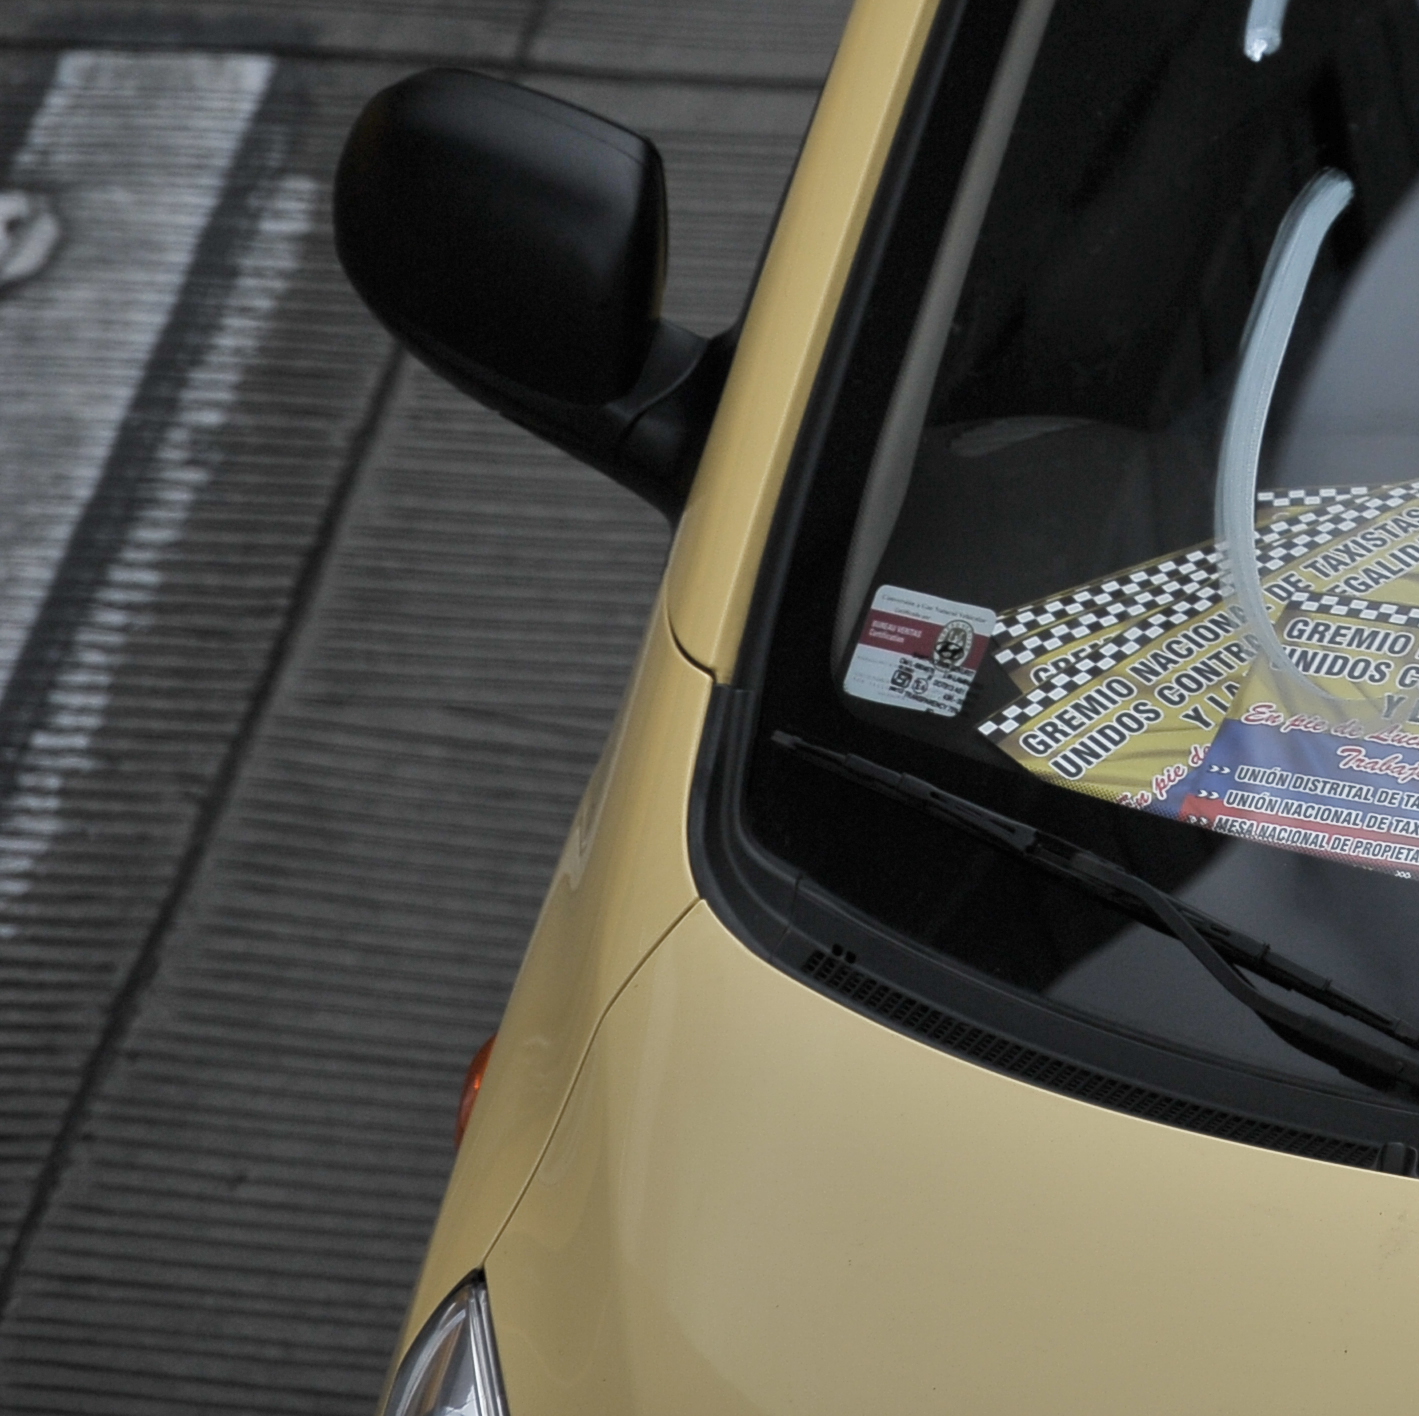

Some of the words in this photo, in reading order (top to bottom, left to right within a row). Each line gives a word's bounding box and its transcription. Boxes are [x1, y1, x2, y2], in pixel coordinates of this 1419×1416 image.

[1285, 617, 1414, 656] GREMIO
[1019, 676, 1138, 758] GREMIO
[1126, 602, 1277, 685] NACIONA
[1180, 704, 1215, 731] Y
[1241, 702, 1284, 727] En
[1280, 711, 1329, 734] pie
[1381, 692, 1406, 720] Y
[1050, 700, 1164, 780] UNIDOS
[1152, 763, 1188, 800] pie
[1235, 765, 1290, 790] UNIÓN
[1290, 774, 1374, 805] DISTRITAL
[1375, 787, 1402, 808] DE
[1223, 790, 1279, 818] UNIÓN
[1279, 799, 1365, 830] NACIONAL
[1365, 812, 1391, 834] DE
[1213, 815, 1258, 840] MESA
[1258, 822, 1330, 851] NACIONAL
[1330, 834, 1353, 854] DE
